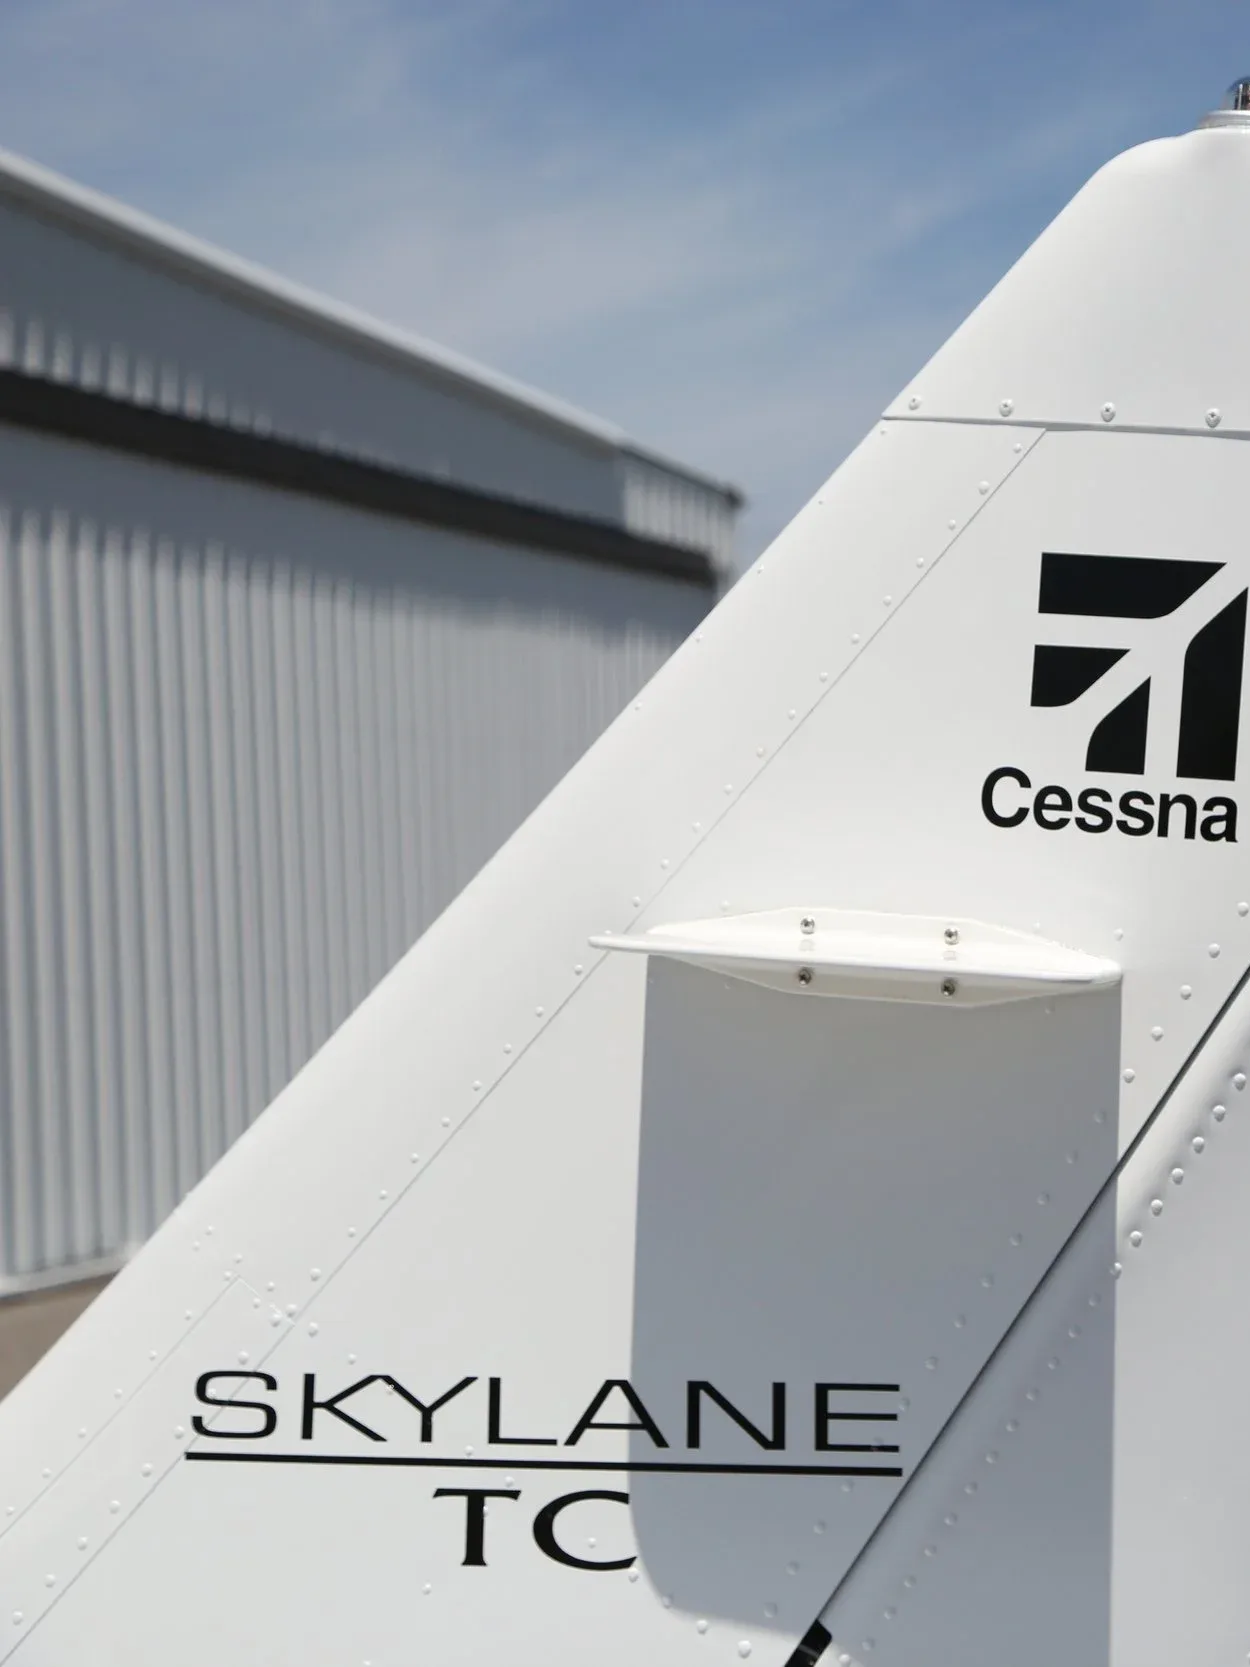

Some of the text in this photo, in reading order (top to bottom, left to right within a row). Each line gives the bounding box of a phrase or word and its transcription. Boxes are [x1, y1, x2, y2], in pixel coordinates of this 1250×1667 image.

[981, 766, 1238, 843] Cessna
[191, 1370, 901, 1454] SKYLANE
[432, 1487, 637, 1571] TC
